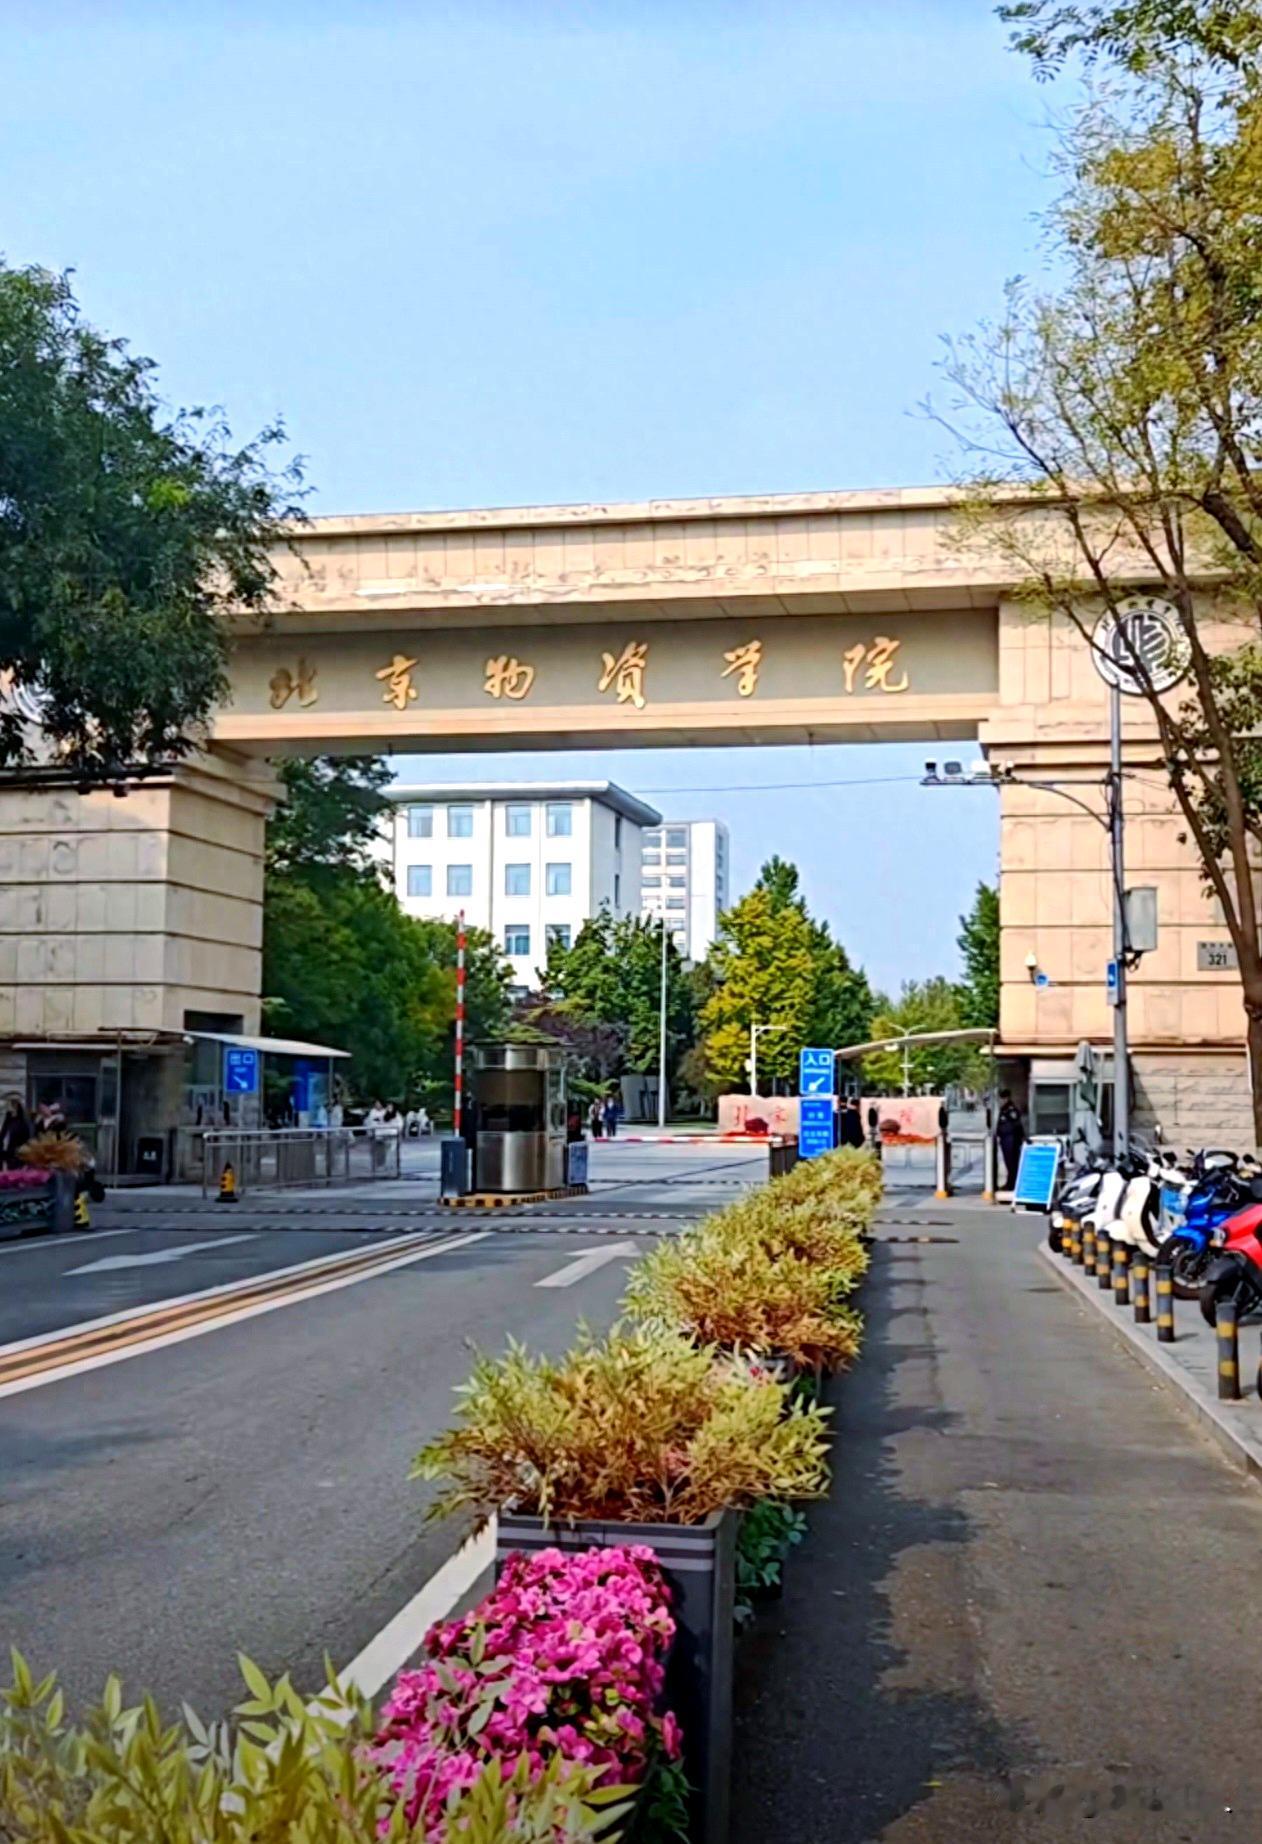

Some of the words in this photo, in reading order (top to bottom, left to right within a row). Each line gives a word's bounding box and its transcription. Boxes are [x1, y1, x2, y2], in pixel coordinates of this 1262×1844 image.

[268, 635, 909, 711] 北京物资学院
[1208, 953, 1227, 966] 321
[804, 1052, 831, 1066] 入口
